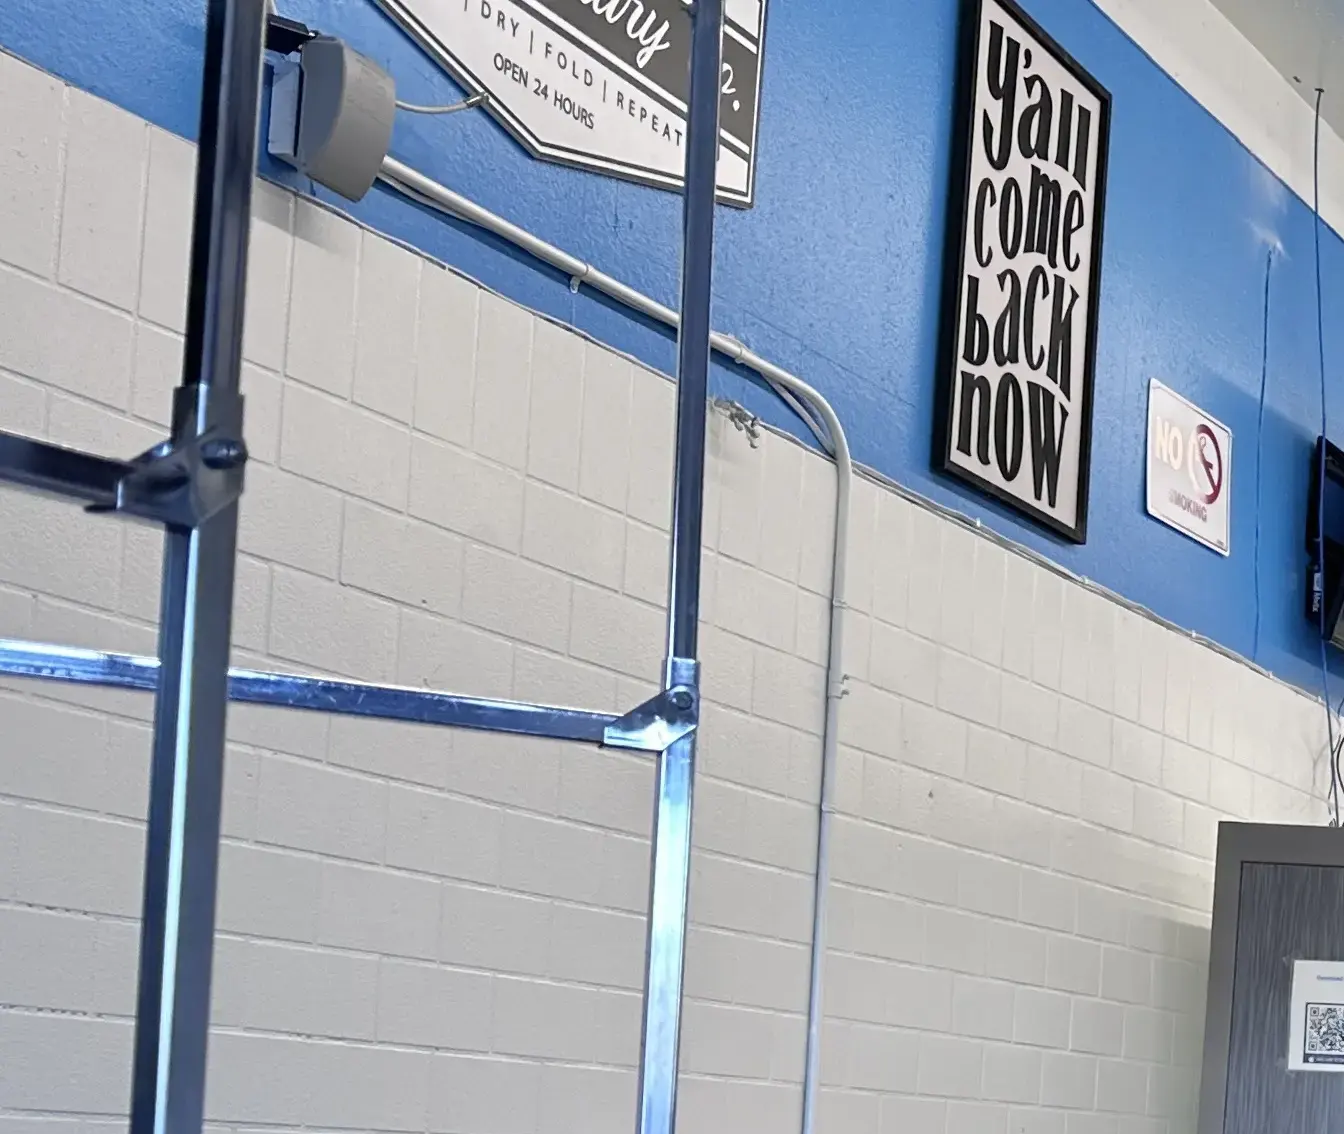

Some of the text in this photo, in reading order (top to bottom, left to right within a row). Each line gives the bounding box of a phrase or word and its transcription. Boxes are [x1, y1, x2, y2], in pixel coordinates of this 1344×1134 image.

[481, 1, 683, 148] DRY FOLD REPEAT
[493, 53, 595, 130] OPEN 24 HOURS
[974, 162, 1085, 272] come
[957, 369, 1068, 509] now
[1155, 416, 1183, 470] NO
[1169, 488, 1208, 523] SMOKING
